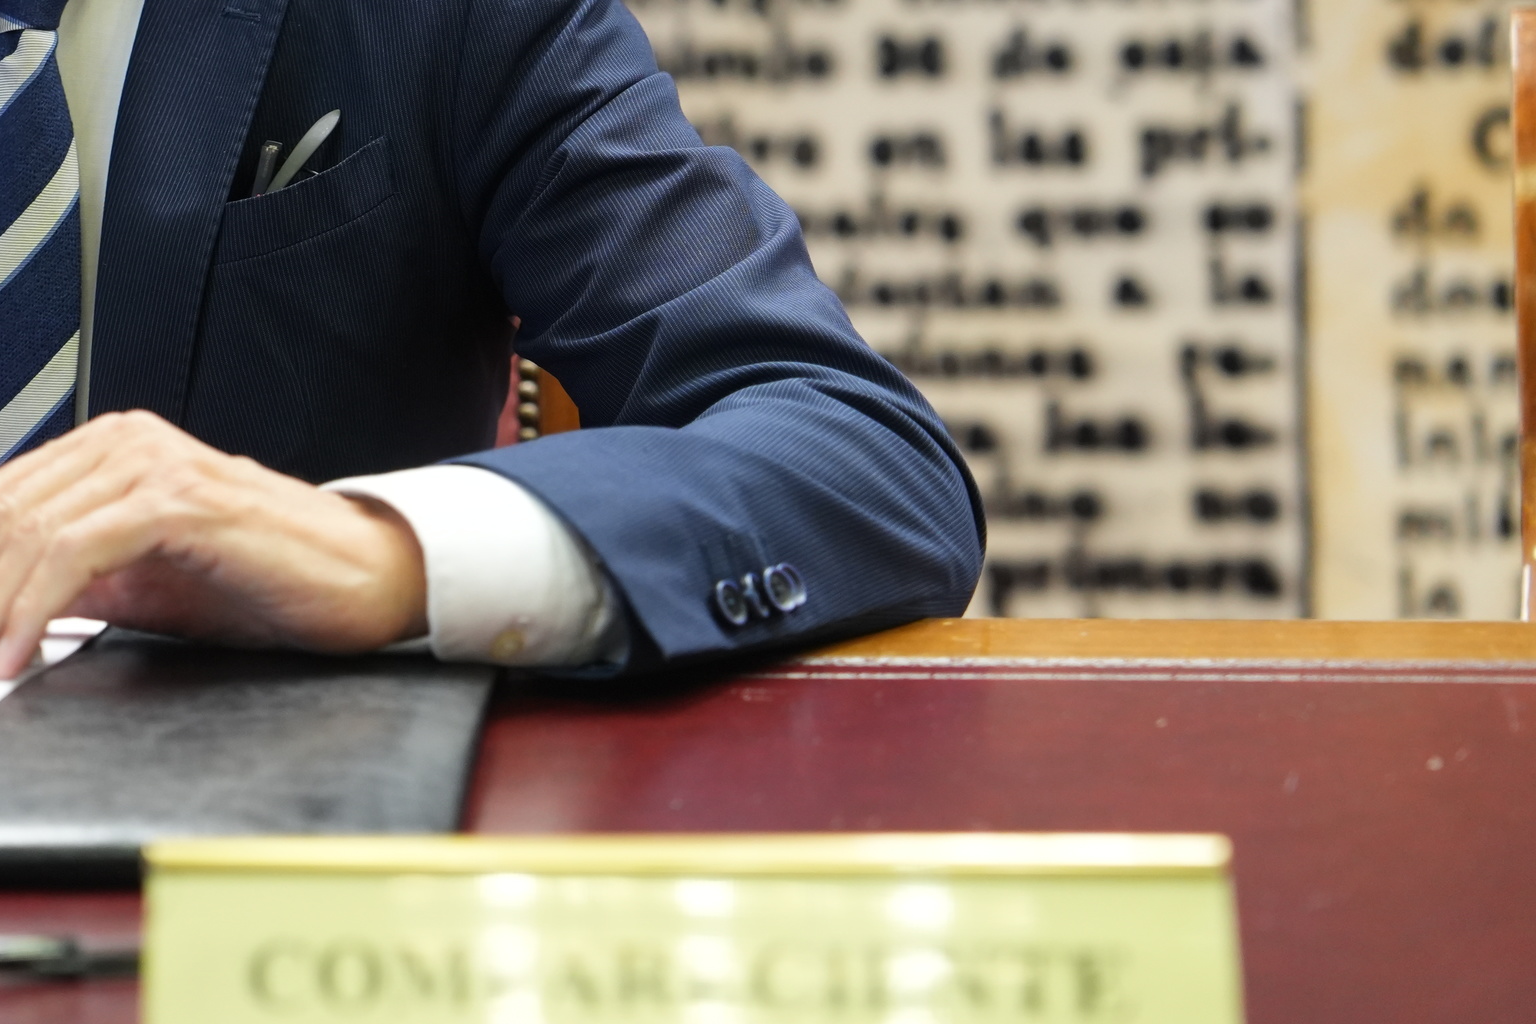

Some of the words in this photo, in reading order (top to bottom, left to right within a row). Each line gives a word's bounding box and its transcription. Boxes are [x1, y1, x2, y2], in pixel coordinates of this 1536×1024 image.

[986, 14, 1080, 86] de
[864, 126, 950, 178] en
[986, 98, 1094, 175] las
[1008, 195, 1156, 259] que
[1206, 246, 1280, 316] la
